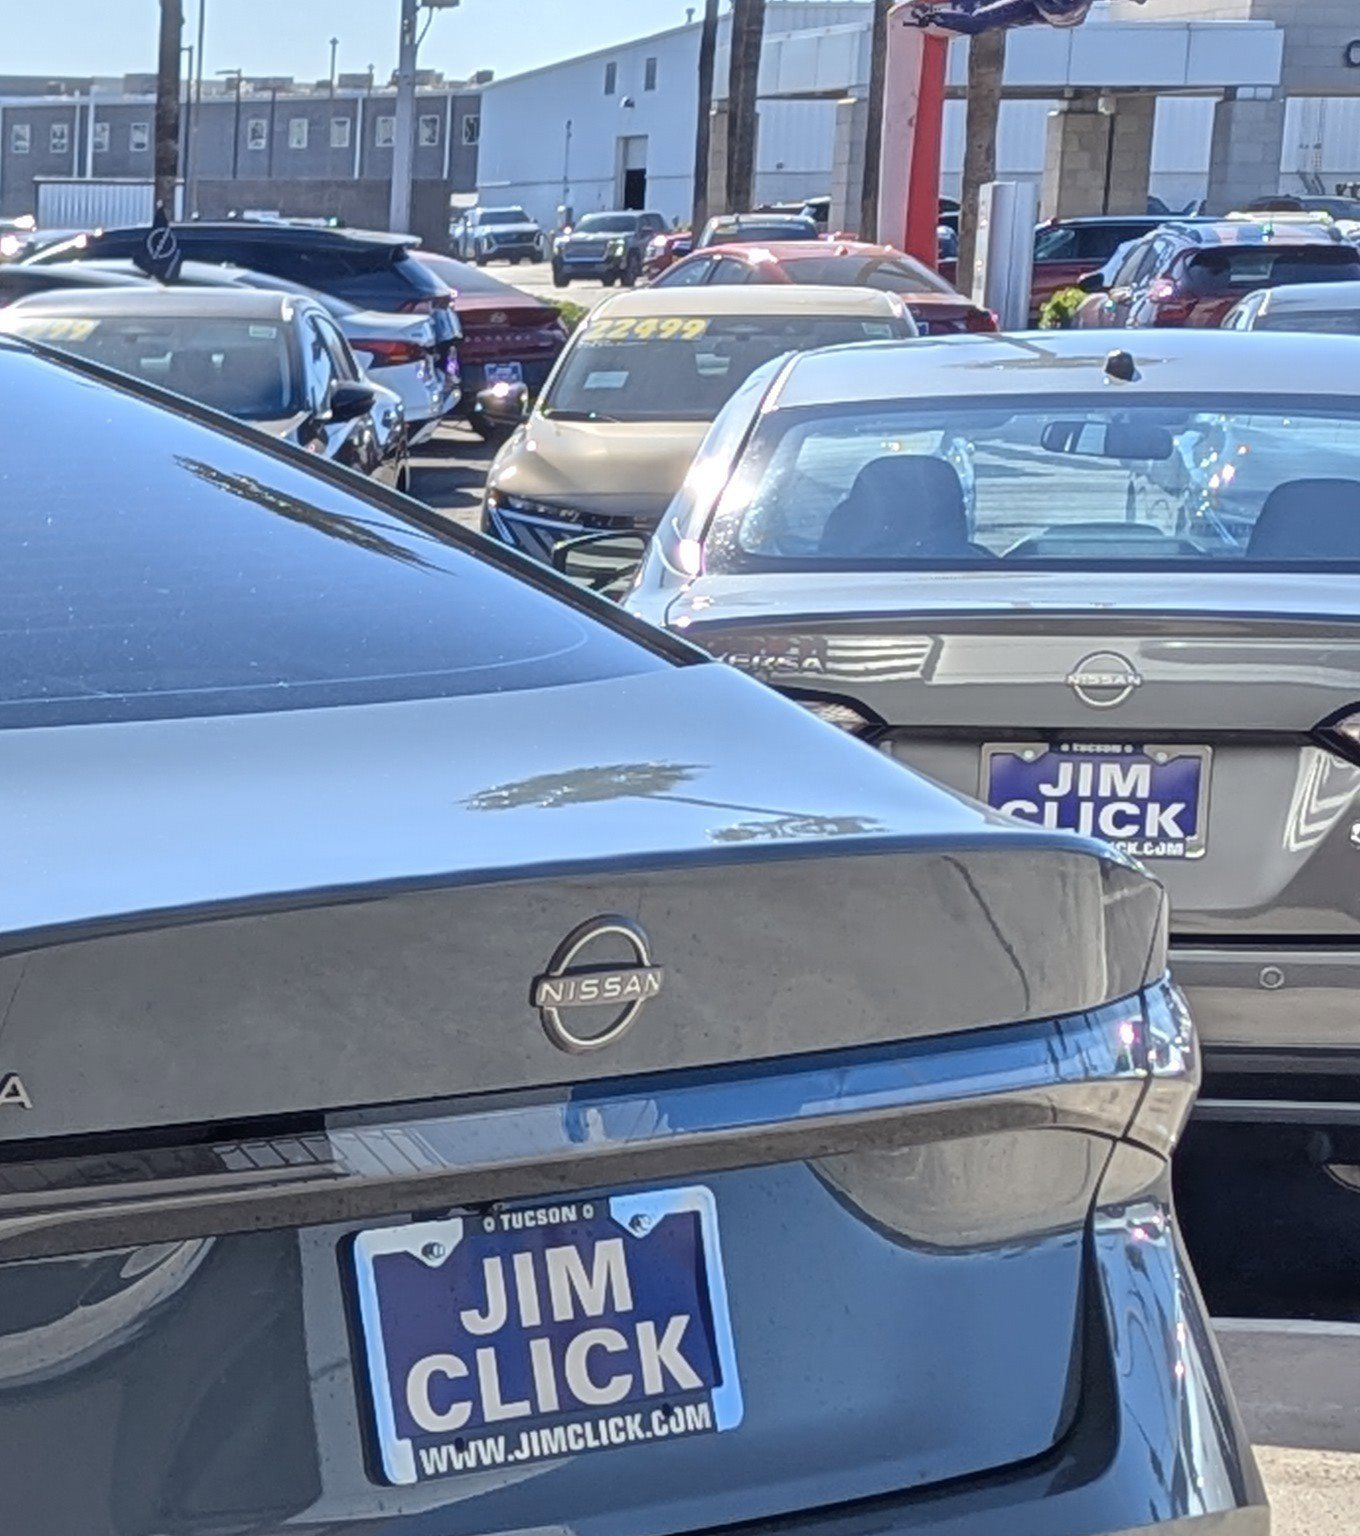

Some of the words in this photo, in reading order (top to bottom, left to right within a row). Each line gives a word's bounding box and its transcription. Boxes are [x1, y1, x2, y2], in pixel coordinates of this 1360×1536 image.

[583, 316, 708, 342] 22499
[1067, 673, 1142, 686] NISSAN
[1038, 761, 1152, 799] JIM
[538, 970, 663, 1005] NISSAN
[499, 1206, 578, 1232] TUCSON
[459, 1237, 634, 1336] JIM
[405, 1314, 705, 1434] CLICK
[419, 1401, 713, 1477] WWW.JIMCLICK.COM
